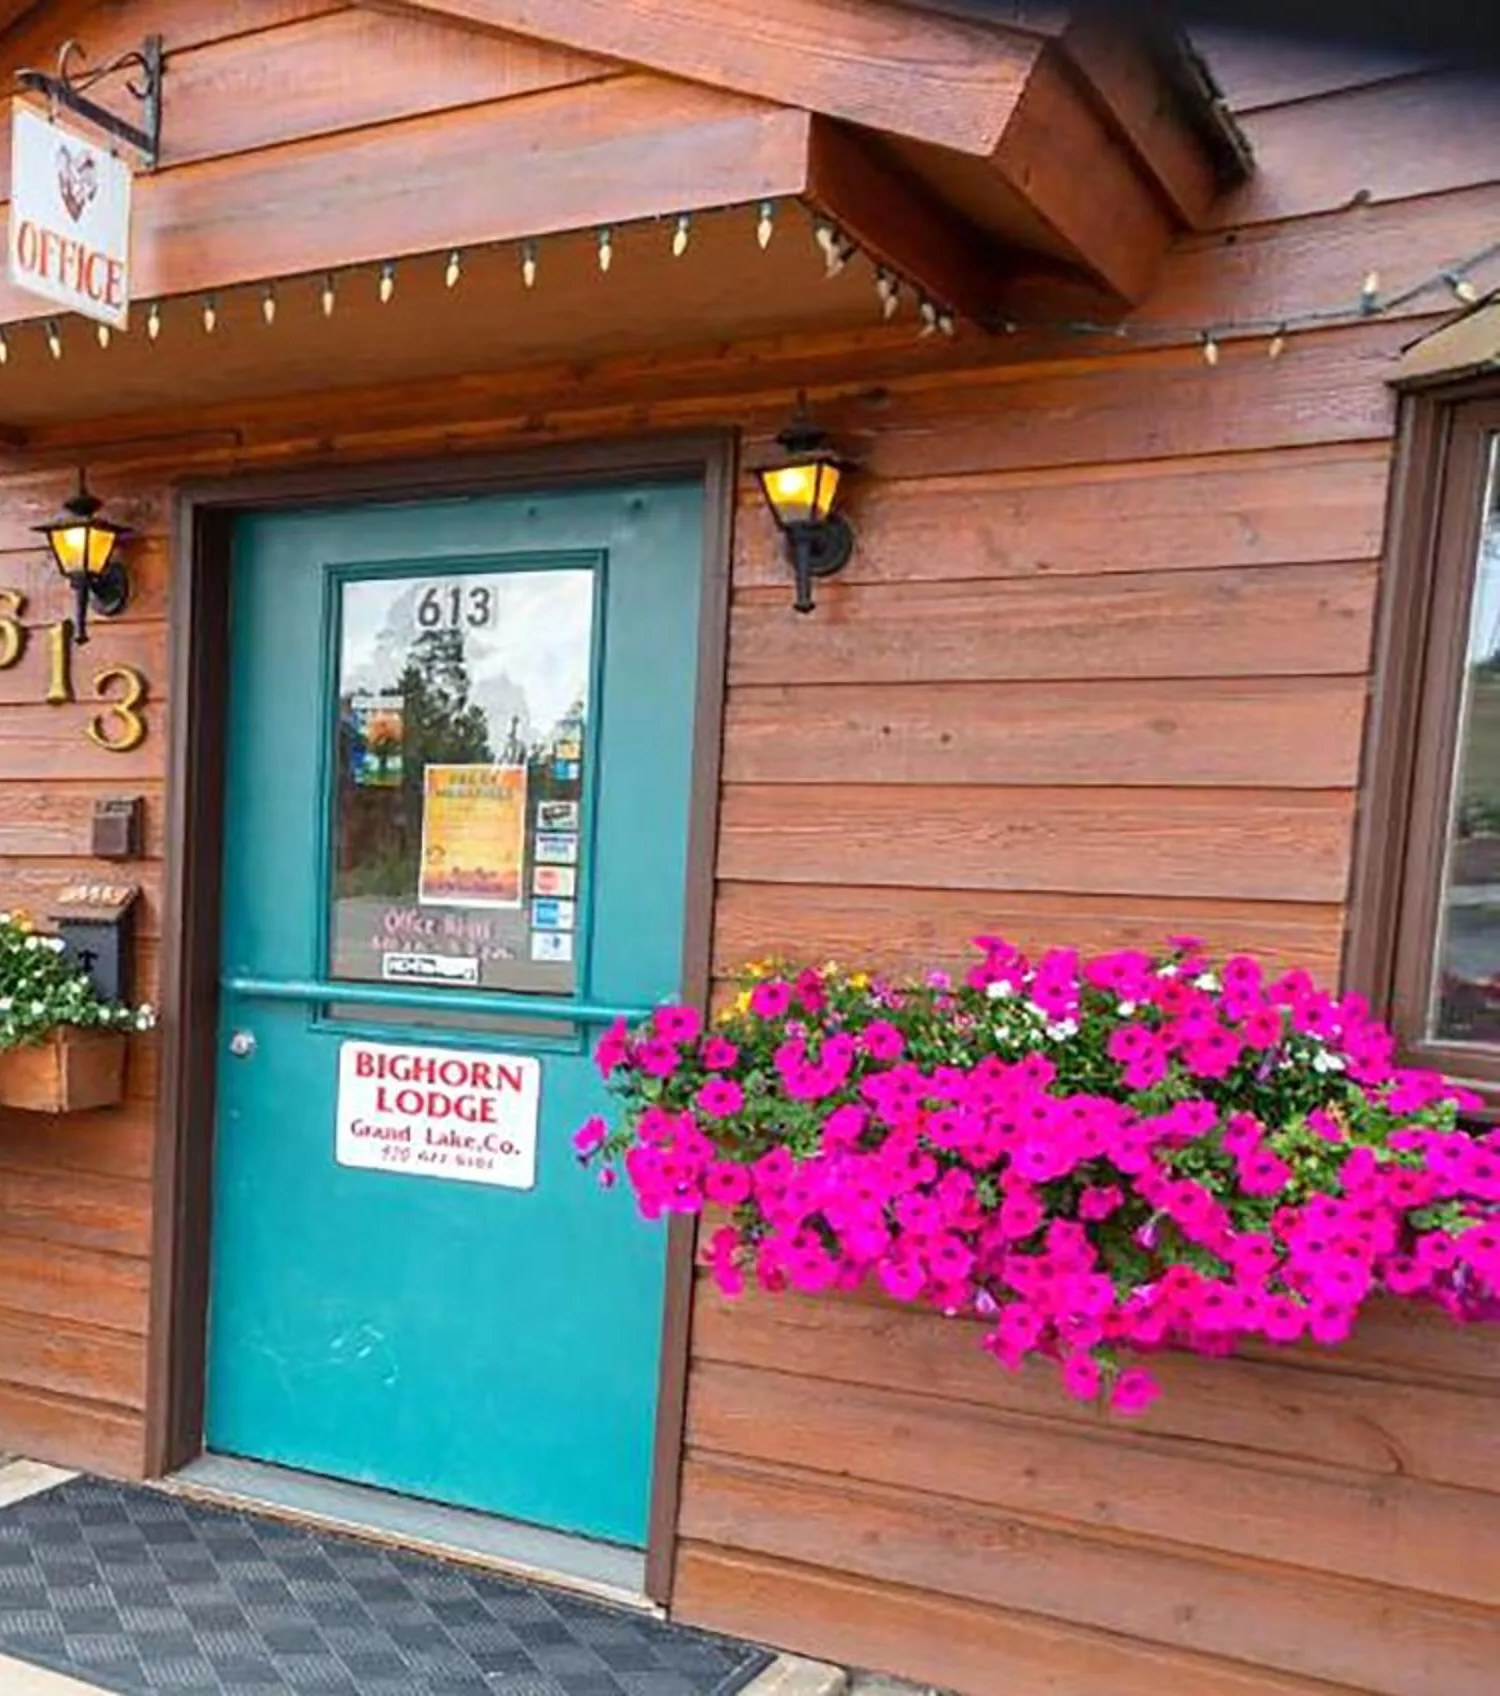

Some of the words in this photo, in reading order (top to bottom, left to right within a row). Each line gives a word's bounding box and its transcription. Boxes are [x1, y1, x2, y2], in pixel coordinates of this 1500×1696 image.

[16, 220, 125, 308] OFFICE
[417, 586, 492, 627] 613
[355, 1051, 523, 1093] BIGHORN
[376, 1087, 498, 1124] LODGE
[350, 1118, 411, 1142] Grand
